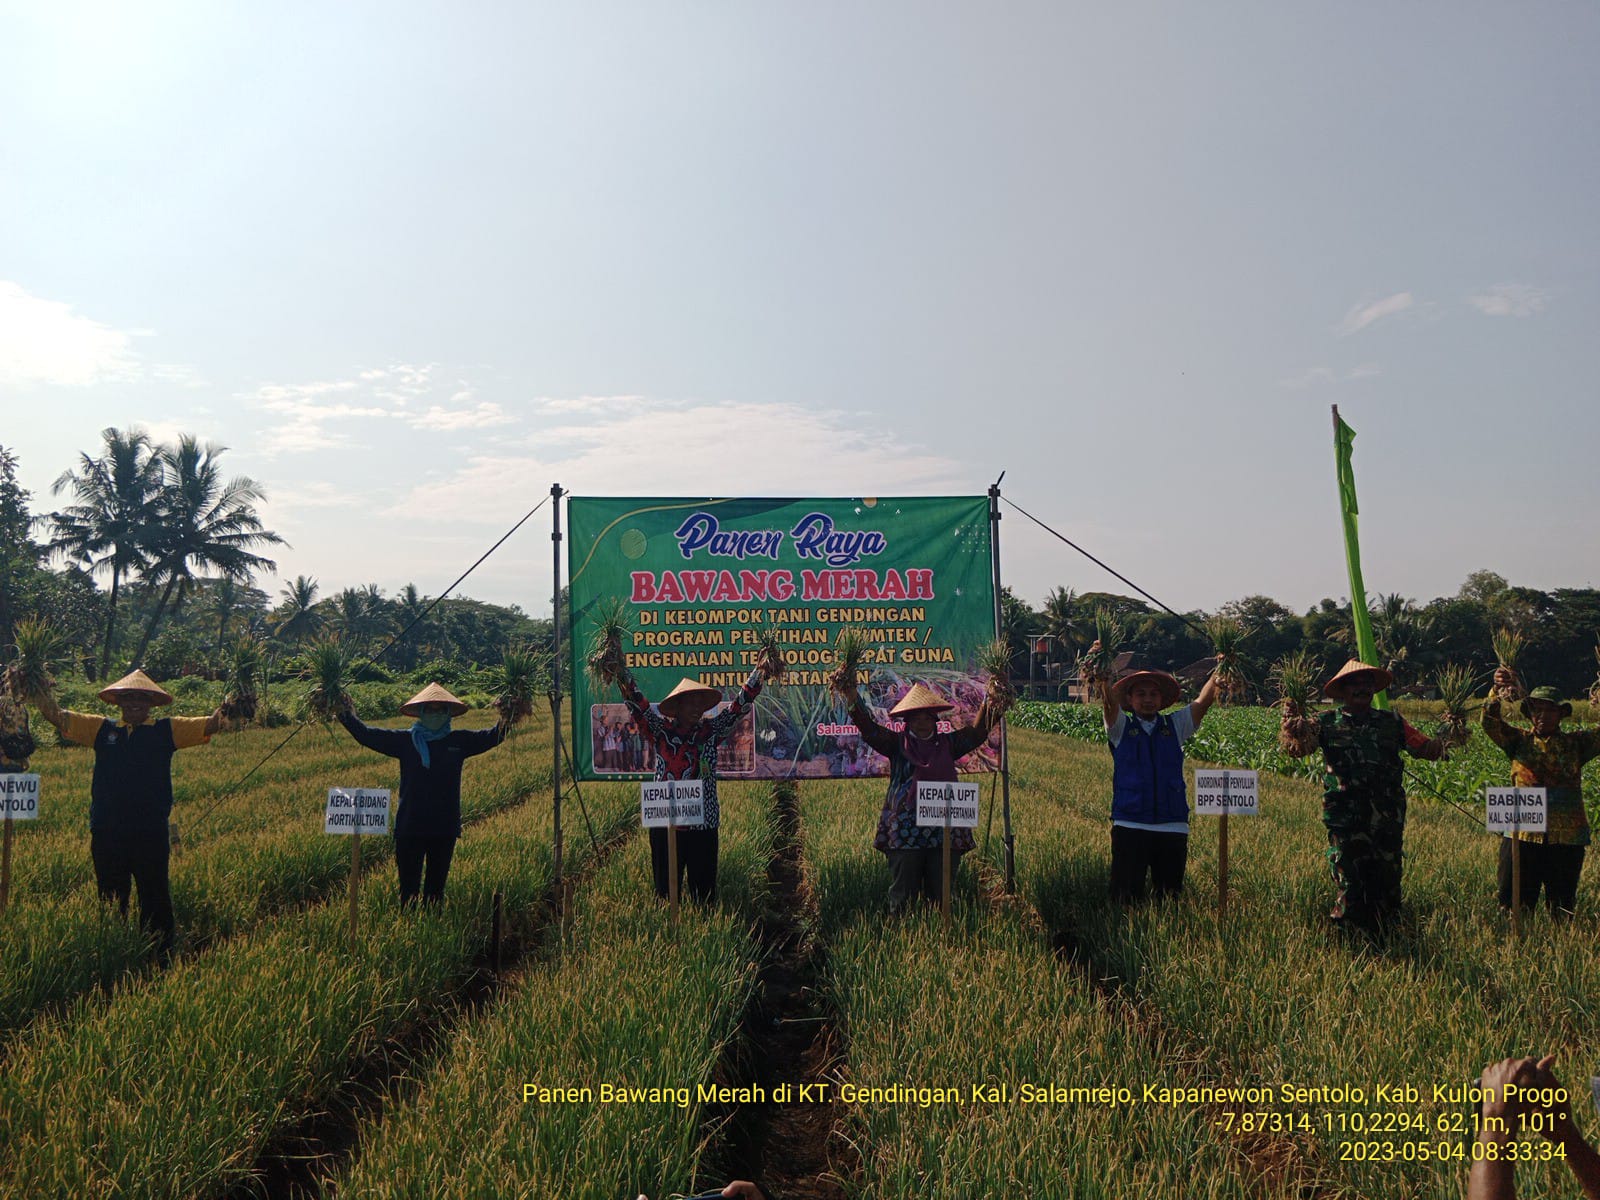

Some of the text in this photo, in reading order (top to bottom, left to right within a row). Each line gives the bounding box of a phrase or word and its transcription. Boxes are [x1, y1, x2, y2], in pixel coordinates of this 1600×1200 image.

[674, 512, 887, 567] Panen Raya
[630, 568, 936, 603] BAWANG MERAH
[639, 607, 926, 626] DI KELOMPOK TANI GENDINGAN
[632, 630, 725, 647] PROGRAM
[730, 628, 829, 646] PELTIHAN
[624, 650, 734, 668] ENGENALAN
[901, 648, 955, 664] GUNA
[699, 672, 750, 688] UNTU
[0, 780, 37, 793] NEWU
[643, 786, 701, 801] KEPALA DINAS
[330, 795, 387, 808] KEPALA BIDANG
[919, 788, 976, 801] KEPALA UPT
[1197, 794, 1255, 807] BPP SENTOLO
[1488, 794, 1543, 806] BABINSA
[328, 813, 385, 827] HORTIKULTURA
[1504, 812, 1544, 824] SALAMREJO
